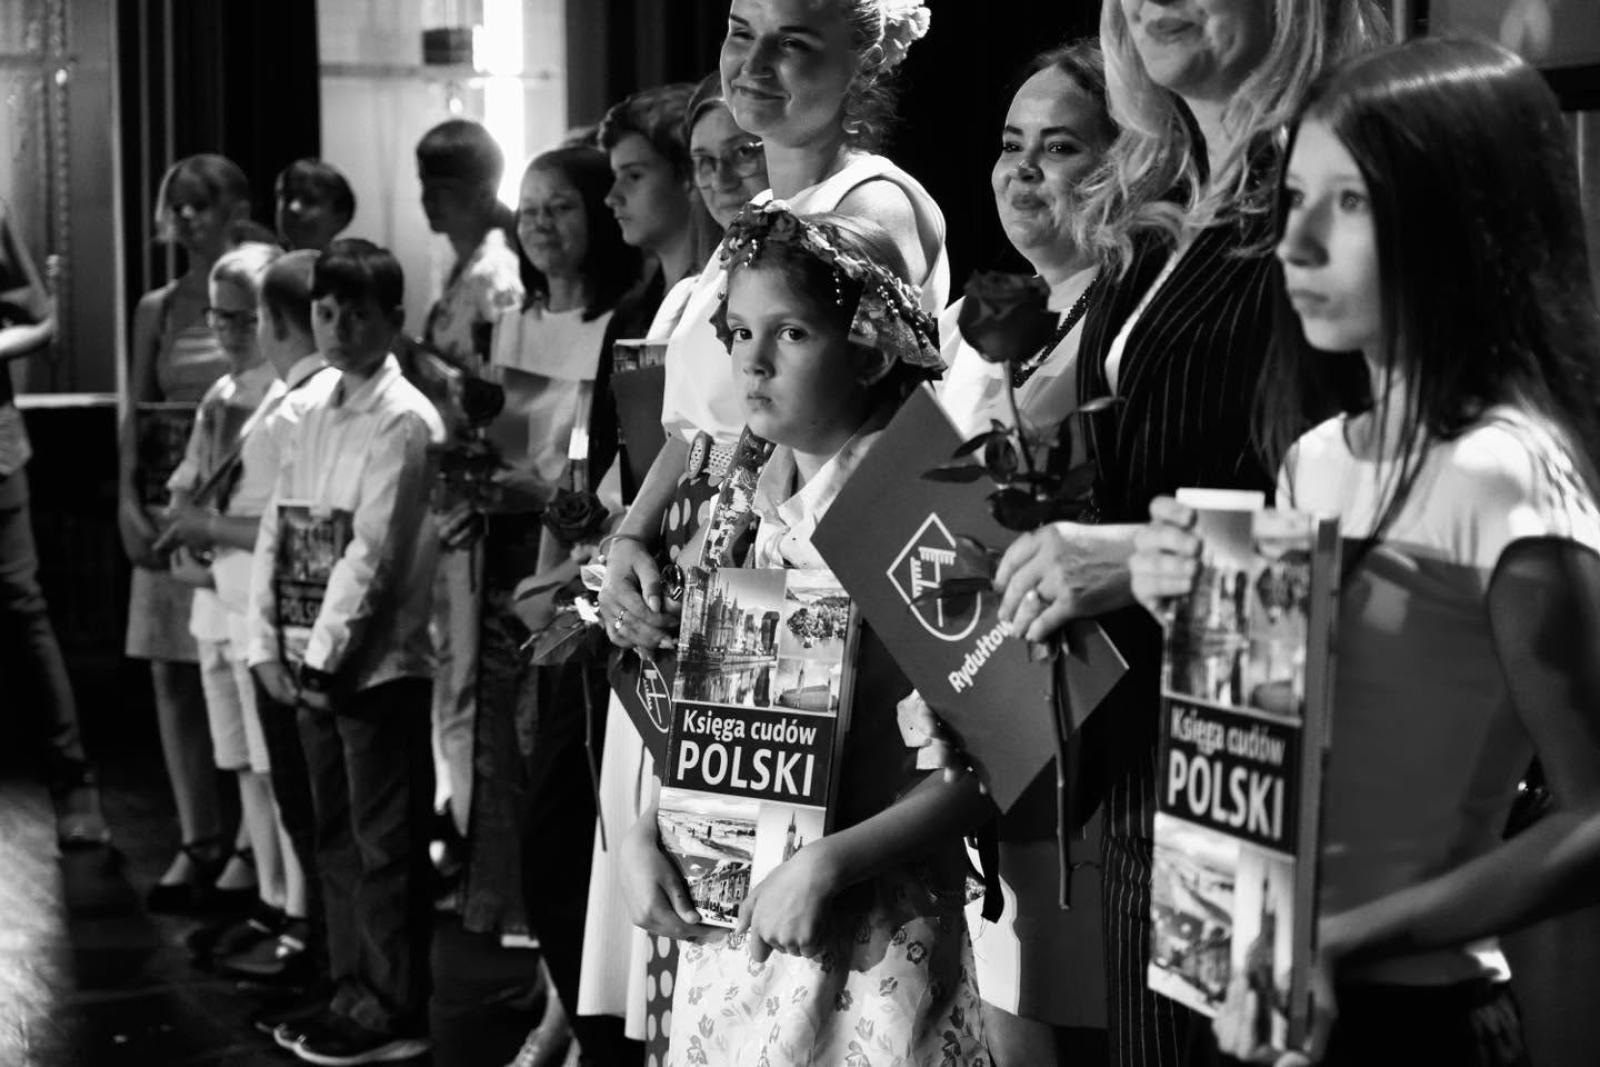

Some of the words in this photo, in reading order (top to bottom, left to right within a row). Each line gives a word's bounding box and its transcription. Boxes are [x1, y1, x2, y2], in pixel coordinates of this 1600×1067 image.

[948, 620, 1013, 693] Rydułtow
[682, 709, 746, 743] Księga
[750, 717, 817, 746] cudów
[1170, 705, 1225, 757] Księga
[676, 739, 816, 797] POLSKI
[1167, 748, 1285, 841] POLSKI
